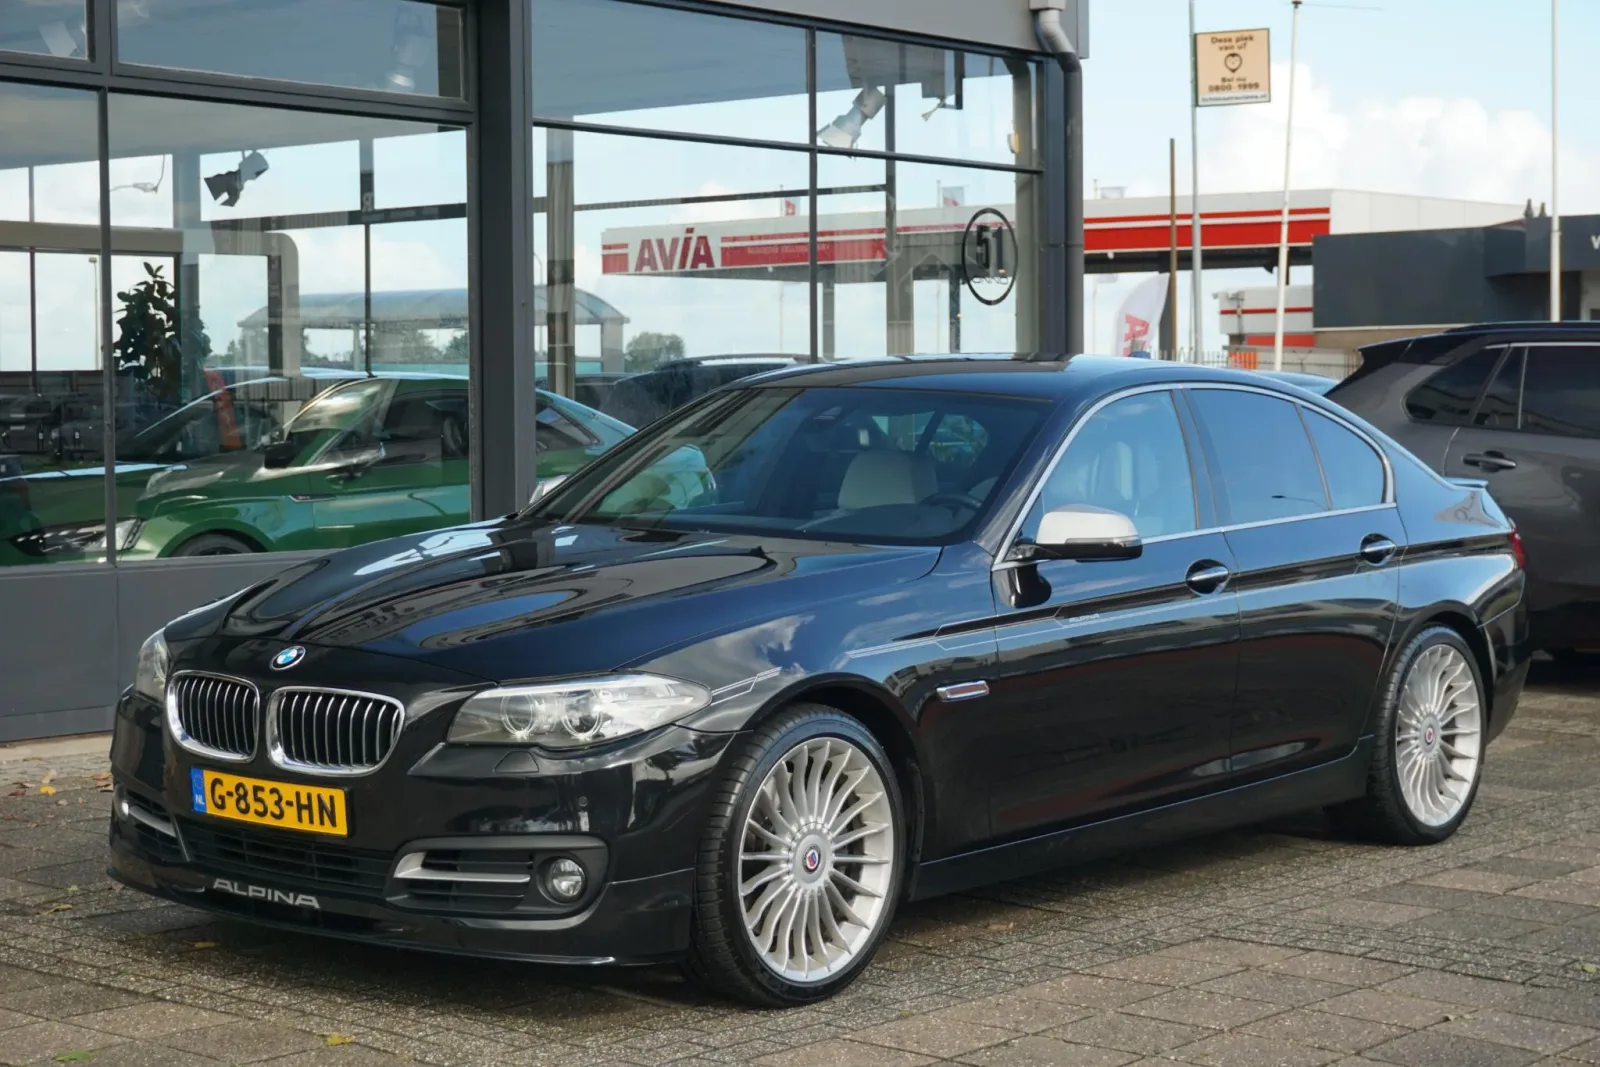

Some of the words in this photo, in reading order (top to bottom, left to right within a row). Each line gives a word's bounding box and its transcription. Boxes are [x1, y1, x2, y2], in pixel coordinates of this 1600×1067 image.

[976, 226, 1003, 268] 51
[196, 795, 205, 805] NL
[210, 777, 337, 827] G-853-HN
[213, 878, 320, 908] ALPINA
